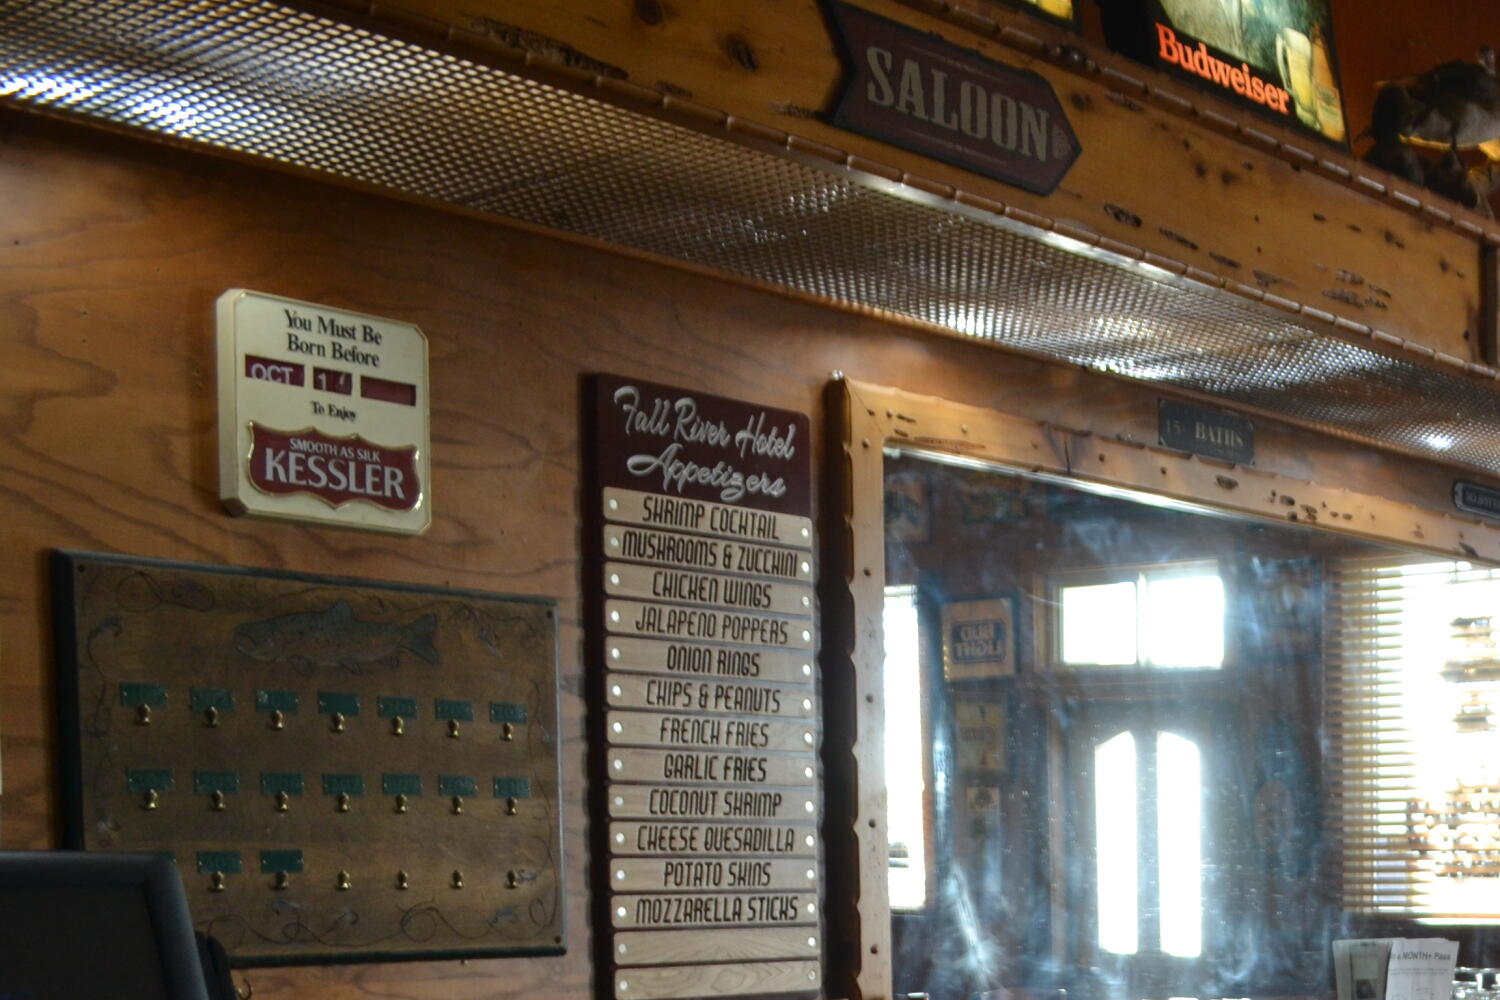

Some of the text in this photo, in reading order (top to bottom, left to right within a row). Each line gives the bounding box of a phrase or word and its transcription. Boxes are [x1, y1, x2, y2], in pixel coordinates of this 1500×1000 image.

[1155, 23, 1290, 116] Budweiser
[866, 46, 1050, 163] SALOON
[284, 309, 382, 345] You Must Be
[287, 333, 380, 368] Born Before
[251, 364, 294, 384] OCT
[311, 401, 356, 422] To Enjoy
[613, 386, 796, 460] Fall River Hotel
[289, 438, 381, 463] SMOOTH AS SILK
[1195, 421, 1245, 448] BATHS
[265, 448, 405, 499] KESSLER
[626, 442, 787, 502] Appetizers
[642, 496, 780, 540] SHRIMP COCKTAIL
[622, 530, 798, 577] MUSHROOMS & ZUCCHINI
[652, 571, 772, 609] CHICKEN WINGS
[635, 606, 788, 645] JALAPENO POPPERS
[667, 645, 760, 677] ONION RINGS
[646, 680, 781, 713] CHIPS & PEANUTS
[660, 717, 770, 748] FRENCH FRIES
[664, 753, 768, 782] GARLIC FRIES
[649, 788, 782, 818] COCONUT SHRIMP
[637, 825, 794, 852] CHEESE QUESADILLA
[664, 861, 771, 888] POTATO SKINS
[636, 896, 798, 925] MOZZARELLA STICKS
[1403, 951, 1432, 960] MONTH+
[1435, 951, 1451, 961] Pass
